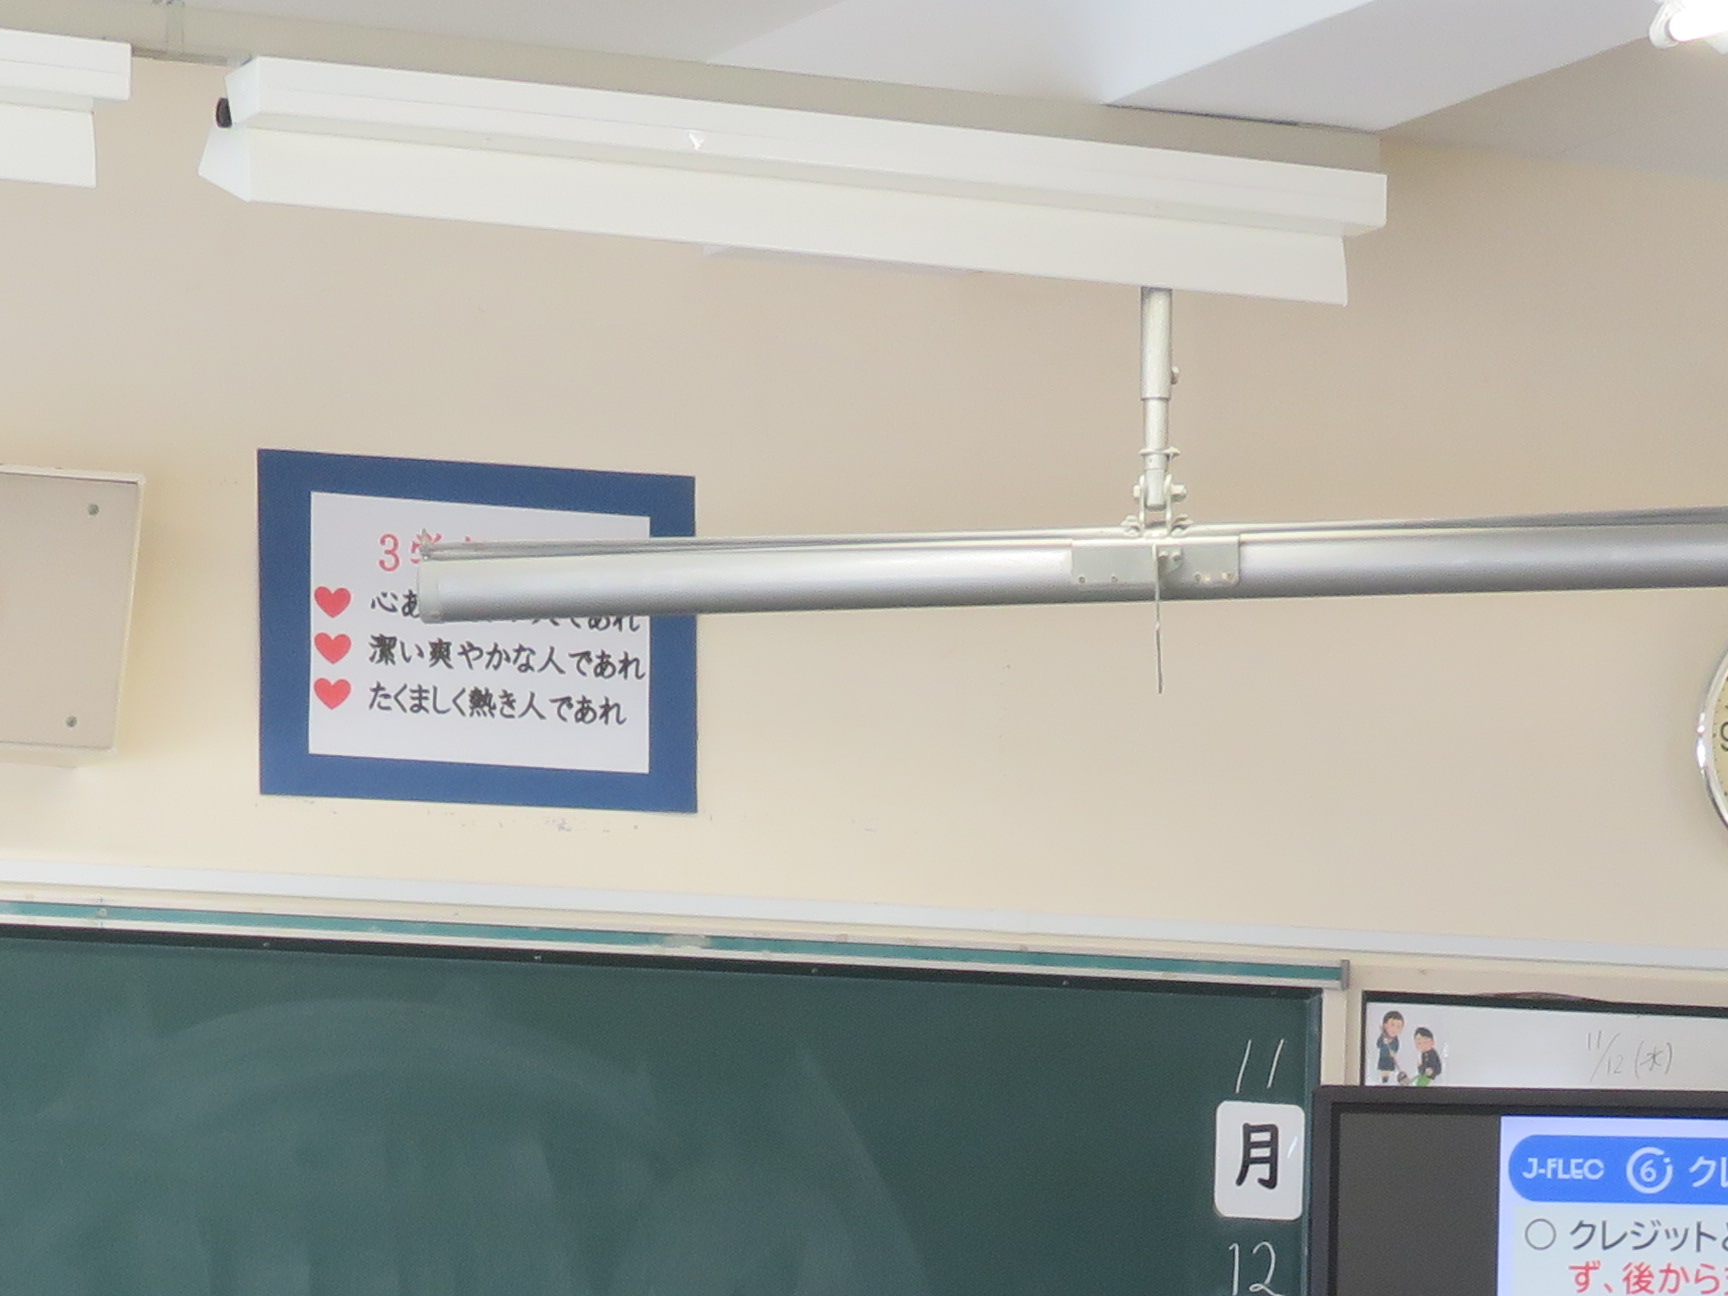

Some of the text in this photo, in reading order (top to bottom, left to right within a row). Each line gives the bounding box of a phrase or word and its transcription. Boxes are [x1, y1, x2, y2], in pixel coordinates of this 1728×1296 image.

[367, 633, 647, 681] 潔い爽やかな人であれ
[367, 681, 628, 726] たくましく熱き人であれ
[1235, 1038, 1285, 1094] 11
[1235, 1121, 1279, 1190] 月
[1522, 1157, 1605, 1181] J-FLEC
